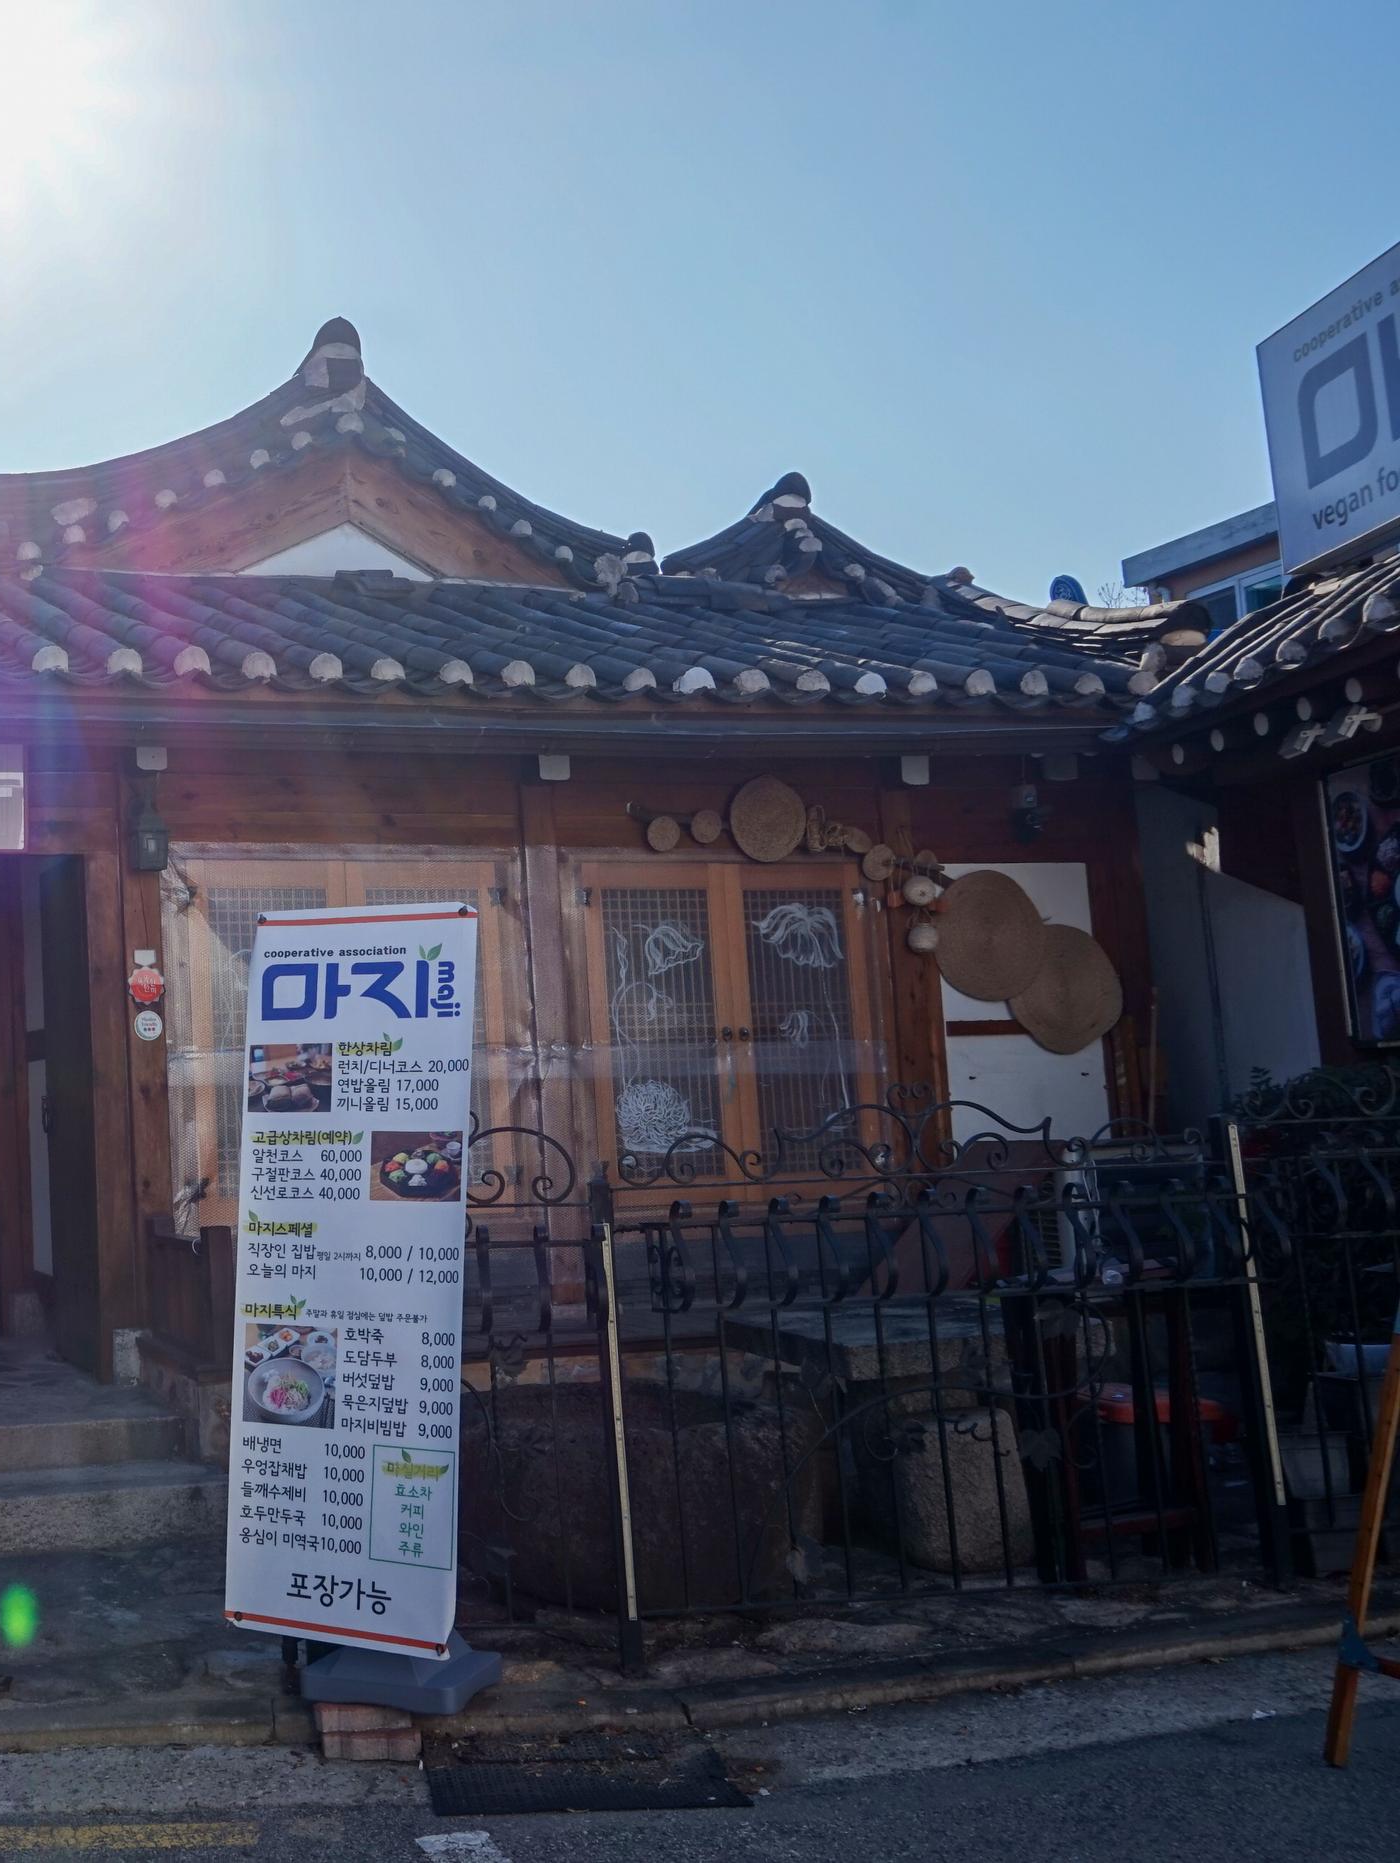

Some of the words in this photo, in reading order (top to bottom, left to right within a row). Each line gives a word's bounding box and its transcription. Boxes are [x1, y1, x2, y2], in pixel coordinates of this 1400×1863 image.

[1294, 291, 1383, 362] cooperative
[1312, 484, 1373, 530] vegan
[264, 948, 334, 959] cooperative
[339, 945, 407, 957] association
[261, 960, 430, 1021] 마지
[430, 961, 461, 1018] maji
[338, 1041, 393, 1057] 한상차림
[338, 1059, 423, 1075] 런치/디너코스
[428, 1058, 470, 1074] 20,000
[337, 1078, 390, 1094] 연밥올림
[397, 1078, 439, 1093] 17,000
[336, 1096, 389, 1112] 끼니올림
[396, 1097, 439, 1112] 15,000
[252, 1130, 352, 1146] 고급상차림(예약)
[252, 1148, 303, 1164] 알천코스
[320, 1149, 362, 1164] 60,000
[251, 1167, 316, 1183] 구절판코스
[320, 1168, 362, 1183] 40,000
[250, 1185, 314, 1201] 신선로코스
[318, 1186, 360, 1202] 40,000
[248, 1221, 313, 1238] 마지스페셜
[247, 1242, 286, 1259] 직장인
[291, 1244, 316, 1260] 집밥
[365, 1245, 402, 1260] 8,000
[406, 1245, 413, 1262] /
[419, 1247, 460, 1263] 10,000
[246, 1263, 287, 1279] 오늘의
[291, 1264, 316, 1280] 마지
[359, 1267, 402, 1283] 10,000
[407, 1268, 413, 1284] /
[419, 1269, 459, 1285] 12,000
[244, 1303, 297, 1321] 마지특식
[344, 1328, 384, 1344] 호박죽
[421, 1331, 455, 1347] 8,000
[343, 1350, 397, 1368] 도담두부
[421, 1354, 455, 1370] 8,000
[342, 1372, 395, 1391] 버섯덮밥
[420, 1377, 454, 1393] 9,000
[342, 1394, 408, 1415] 묵은지덮밥
[419, 1400, 453, 1416] 9,000
[341, 1417, 407, 1438] 마지비빔밥
[418, 1423, 453, 1439] 9,000
[242, 1436, 282, 1454] 배냉면
[324, 1443, 366, 1460] 10,000
[241, 1458, 308, 1480] 우엉잡채밥
[324, 1466, 365, 1483] 10,000
[241, 1481, 306, 1503] 들깨수제비
[323, 1489, 364, 1507] 10,000
[395, 1483, 432, 1501] 효소차
[240, 1504, 306, 1527] 호두만두국
[321, 1513, 363, 1531] 10,000
[400, 1503, 424, 1519] 커피
[399, 1522, 424, 1539] 와인
[239, 1527, 277, 1547] 옹심이
[282, 1532, 320, 1552] 미역국
[320, 1537, 362, 1555] 10,000
[398, 1541, 424, 1558] 주류
[286, 1572, 392, 1615] 포장가능
